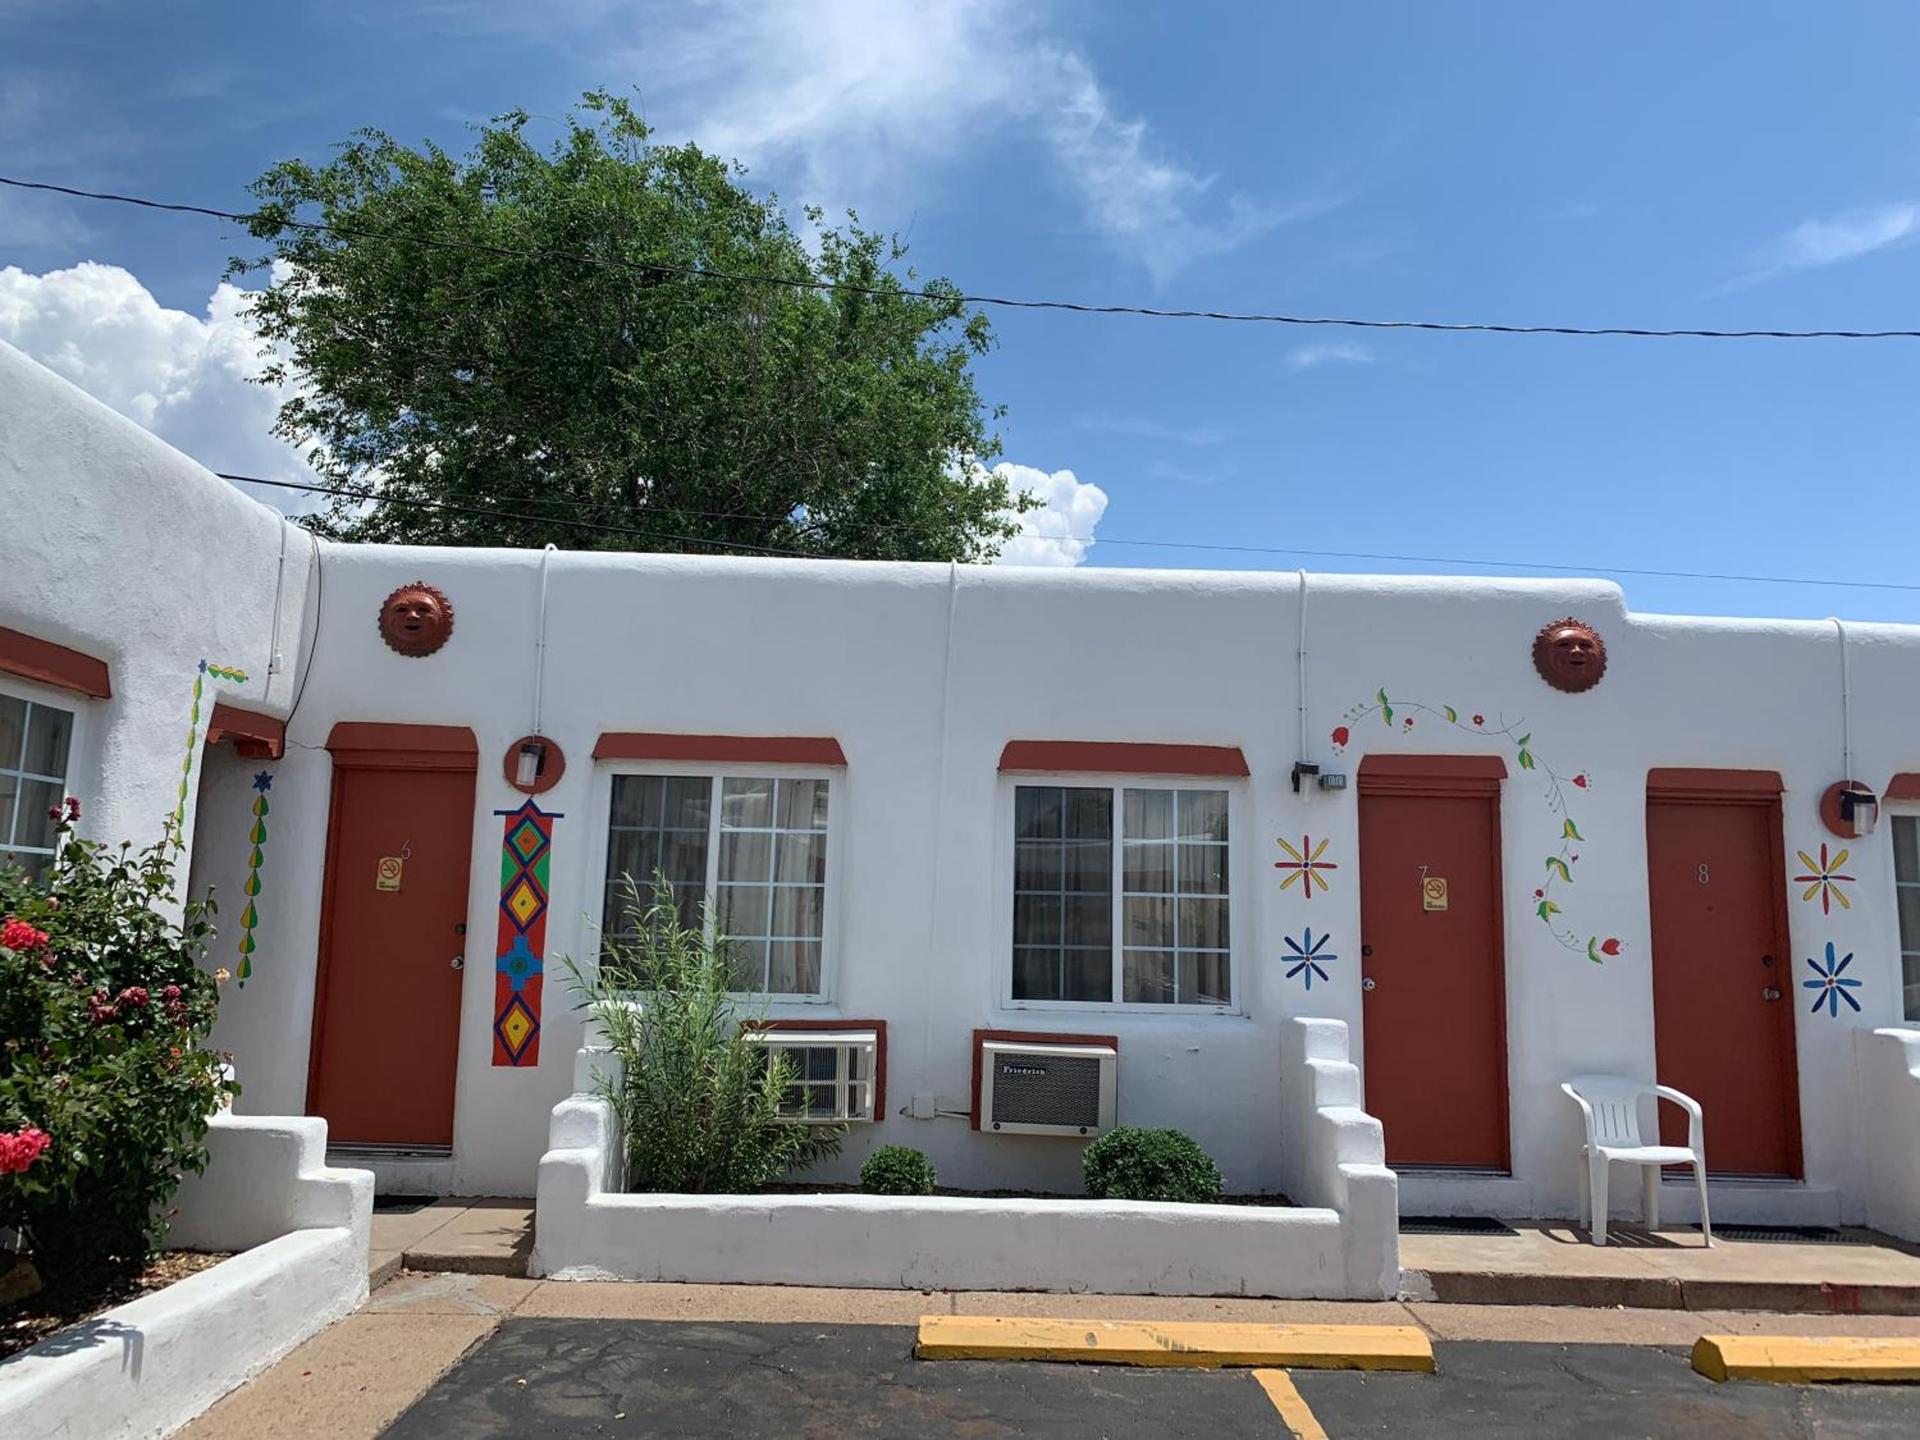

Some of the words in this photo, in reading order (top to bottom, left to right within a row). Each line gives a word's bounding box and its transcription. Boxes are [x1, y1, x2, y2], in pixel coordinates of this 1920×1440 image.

[401, 839, 411, 860] 6
[1418, 865, 1428, 888] 7
[1698, 863, 1709, 884] 8
